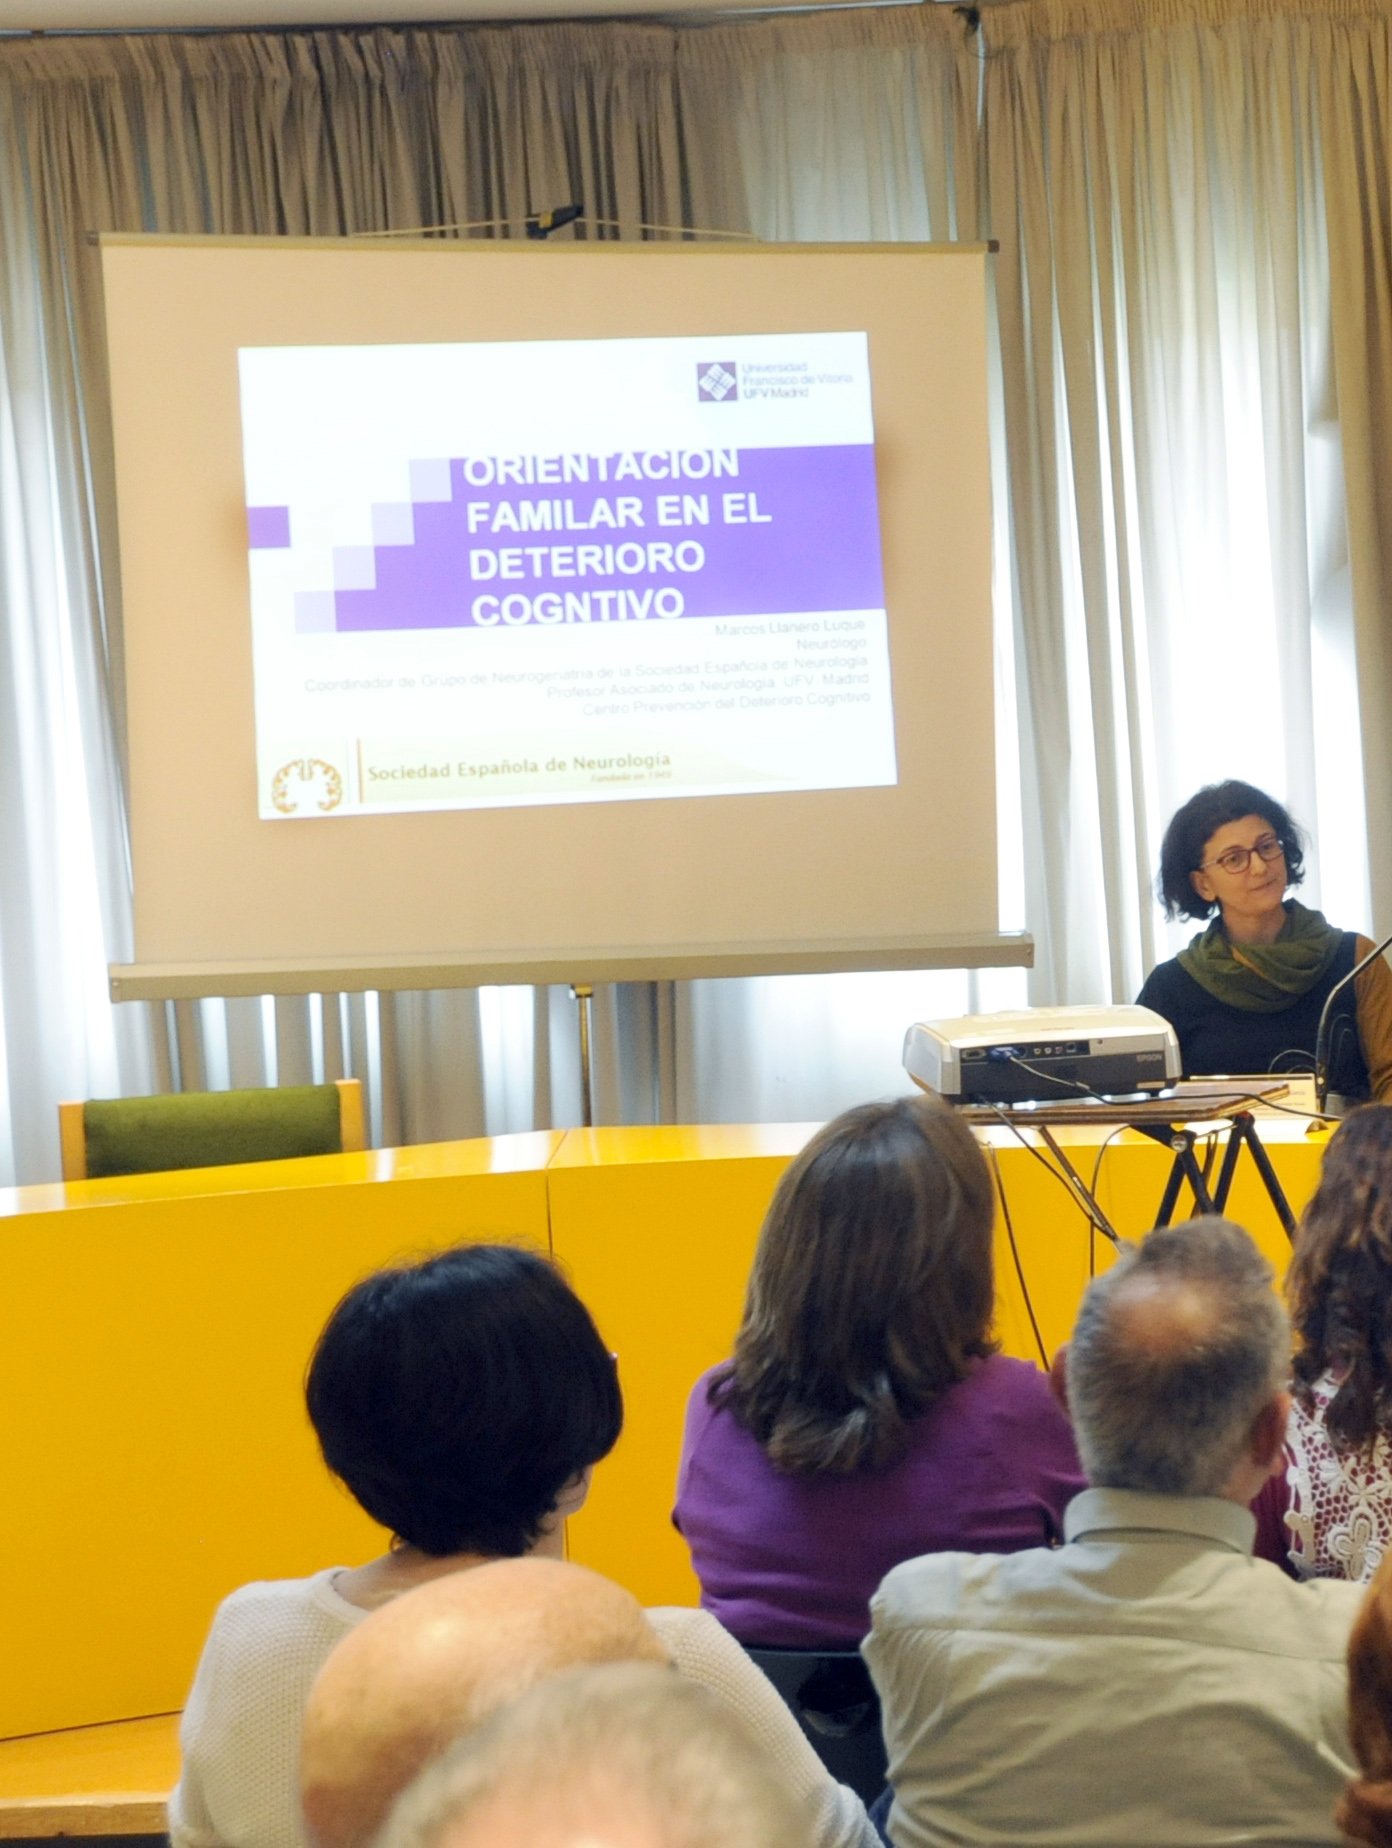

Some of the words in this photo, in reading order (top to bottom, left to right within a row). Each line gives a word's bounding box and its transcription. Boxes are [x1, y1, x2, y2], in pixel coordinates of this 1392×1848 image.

[742, 362, 807, 373] Universidad
[743, 375, 798, 386] Francisco
[800, 374, 815, 385] de
[817, 373, 853, 384] Vitoria
[744, 388, 769, 399] UFV
[771, 387, 809, 398] Madrid
[467, 496, 645, 534] FAMILAR
[656, 493, 710, 526] EN
[722, 491, 773, 524] EL
[469, 540, 705, 581] DETERIORO
[471, 587, 685, 627] COGNTIVO
[715, 624, 766, 636] Marcos
[769, 621, 820, 634] Llanero
[823, 619, 866, 632] Luque
[304, 676, 393, 692] Coordinador
[398, 676, 416, 688] de
[421, 673, 467, 689] Grupo
[471, 672, 487, 684] de
[597, 667, 614, 678] de
[619, 665, 632, 677] la
[635, 663, 700, 677] Sociedad
[705, 660, 768, 674] Española
[772, 659, 789, 670] de
[547, 685, 606, 698] Profesor
[610, 682, 675, 697] Asociado
[678, 680, 695, 692] de
[822, 672, 869, 685] Madrid
[583, 702, 630, 716] Centro
[715, 697, 735, 710] del
[740, 695, 803, 709] Deterioro
[807, 691, 871, 707] Cognitivo
[368, 762, 451, 781] Sociedad
[458, 758, 539, 780] Española
[545, 757, 567, 772] de
